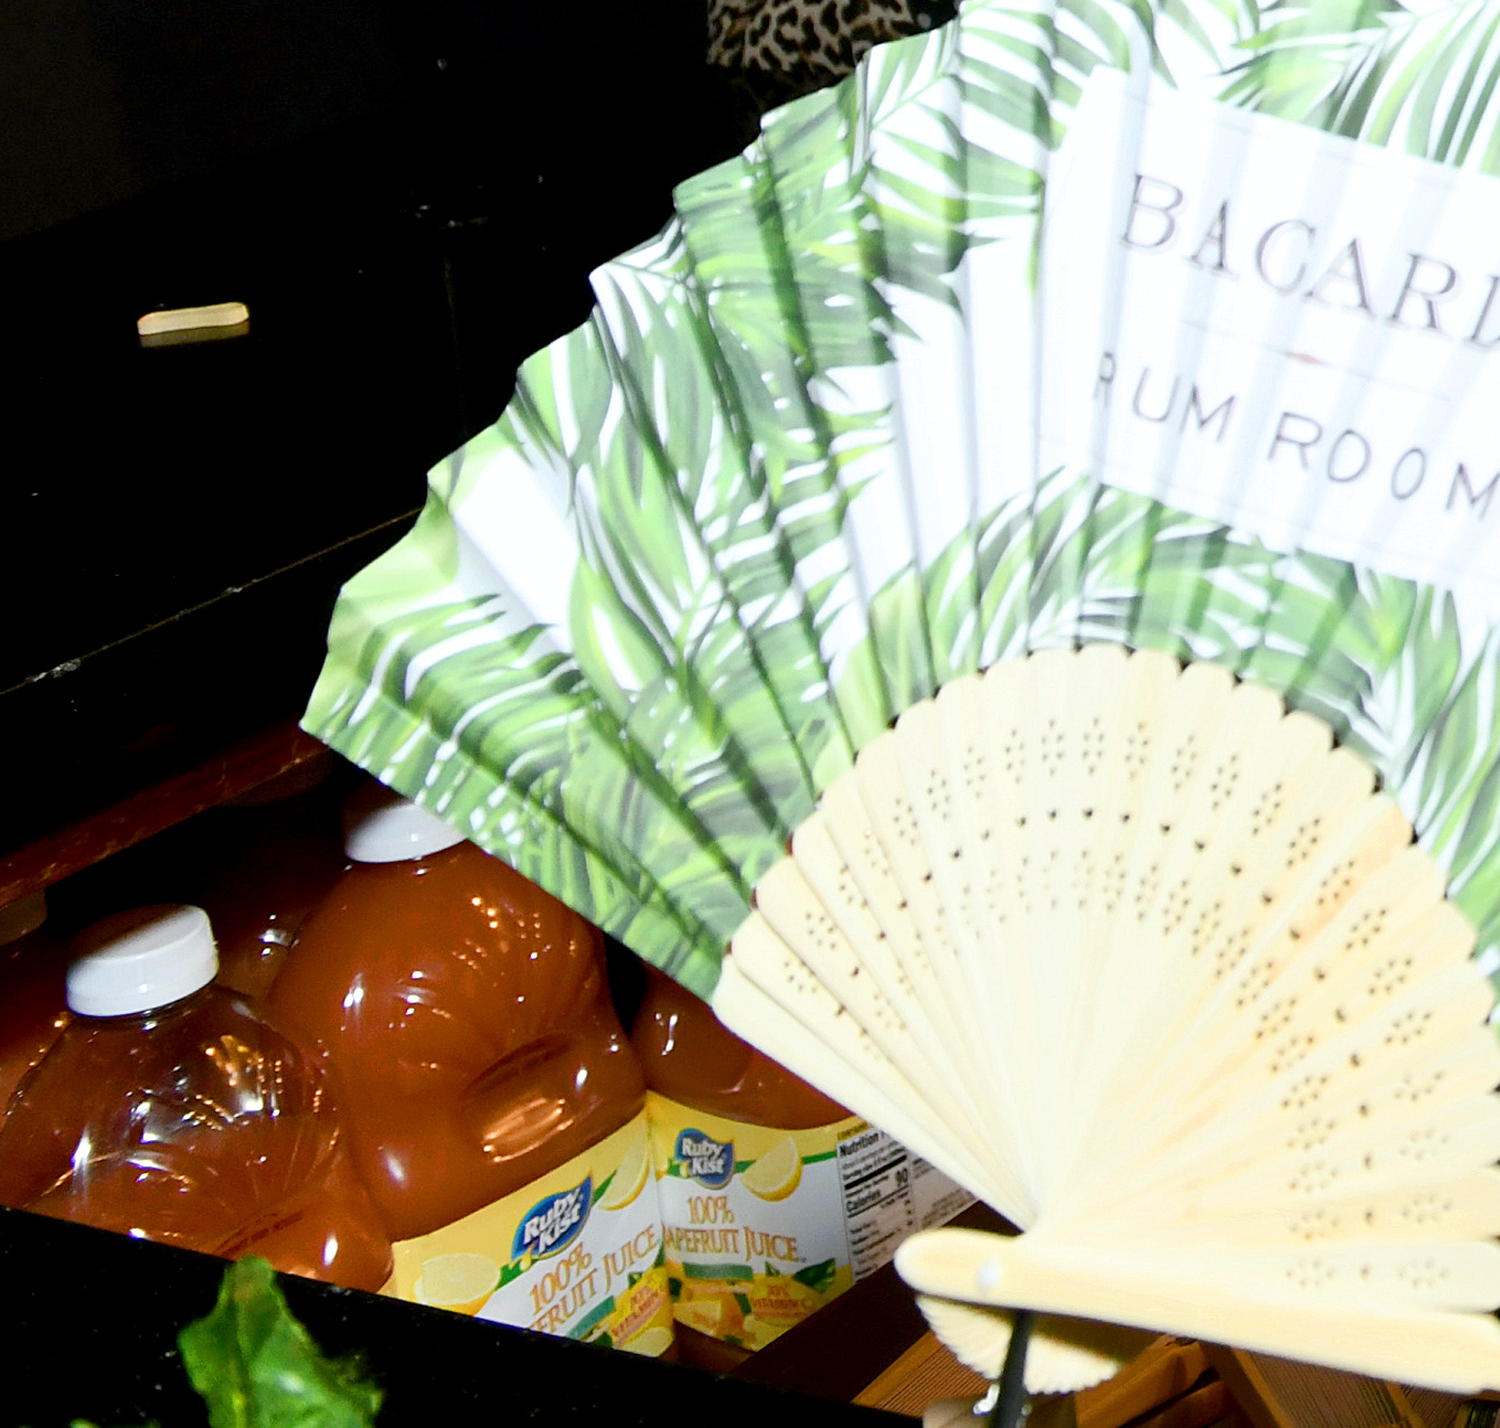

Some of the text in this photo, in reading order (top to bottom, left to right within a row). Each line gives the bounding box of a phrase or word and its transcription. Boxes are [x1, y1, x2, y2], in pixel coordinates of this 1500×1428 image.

[681, 1137, 725, 1159] Ruby
[523, 1187, 582, 1245] Ruby
[688, 1196, 735, 1225] 100%
[662, 1222, 799, 1263] APEFRUIT JUICE
[529, 1224, 658, 1333] FRUIT JUICE
[529, 1242, 592, 1316] 100%
